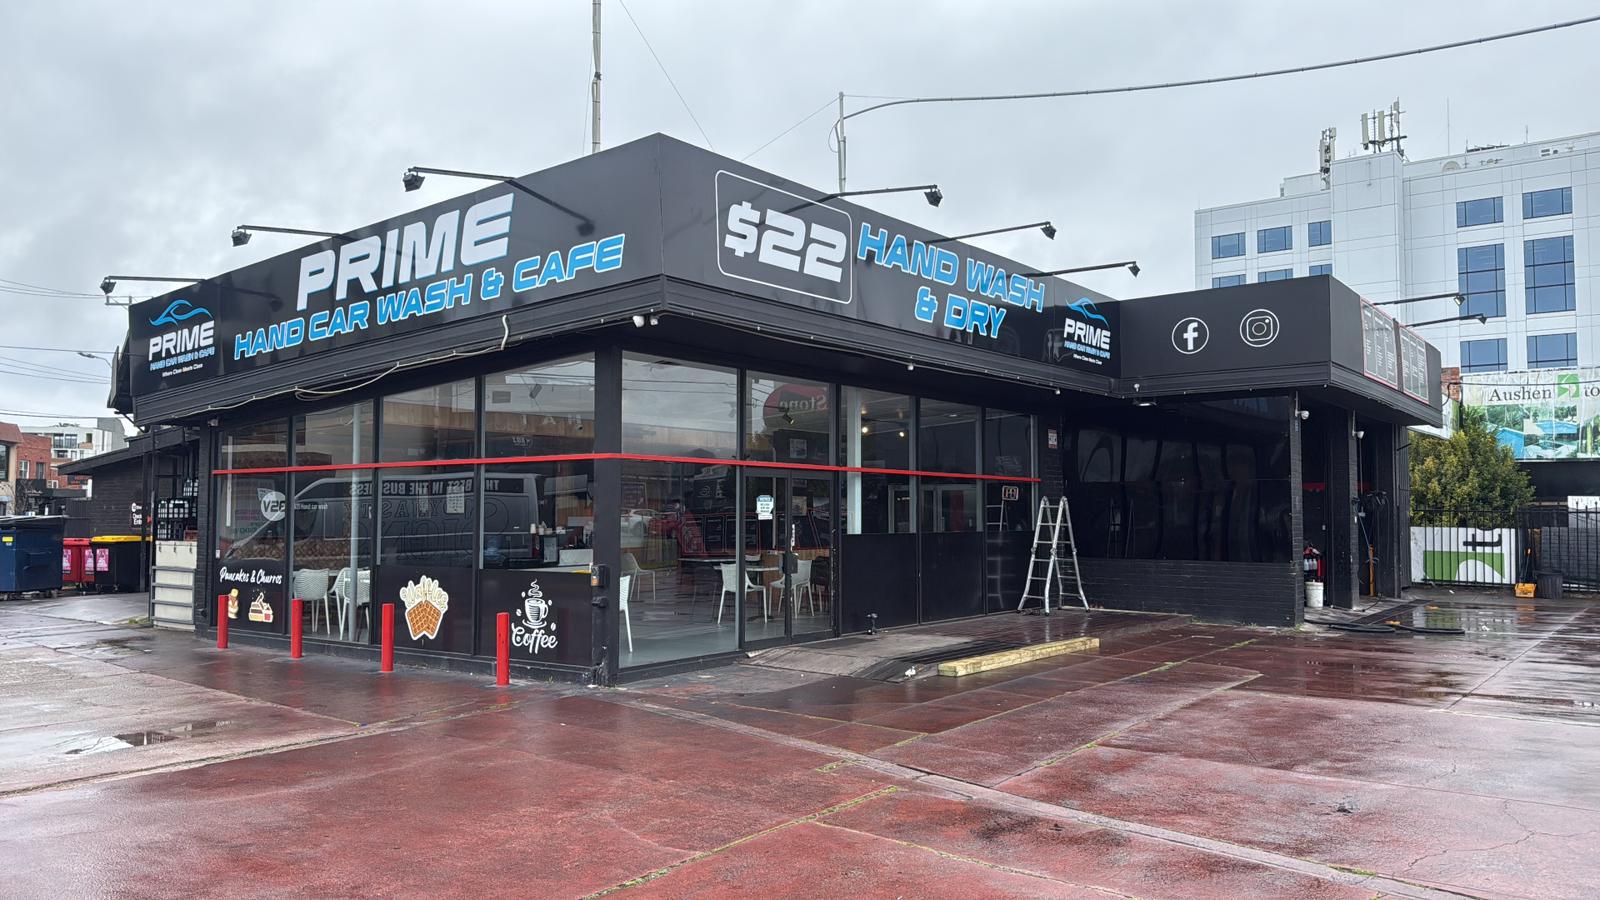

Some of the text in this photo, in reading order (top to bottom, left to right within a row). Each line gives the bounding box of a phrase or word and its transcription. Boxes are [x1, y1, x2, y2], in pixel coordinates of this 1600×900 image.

[297, 192, 514, 311] PRIME
[724, 200, 847, 283] $22
[856, 222, 1046, 313] HAND WASH
[233, 233, 626, 361] HAND CAR WASH & CAFE
[914, 286, 1007, 339] & DRY
[148, 320, 215, 361] PRIME
[1063, 317, 1111, 350] PRIME
[1488, 386, 1552, 402] Aushen
[220, 566, 283, 585] Pancakes & Churros
[511, 622, 558, 655] Coffee
